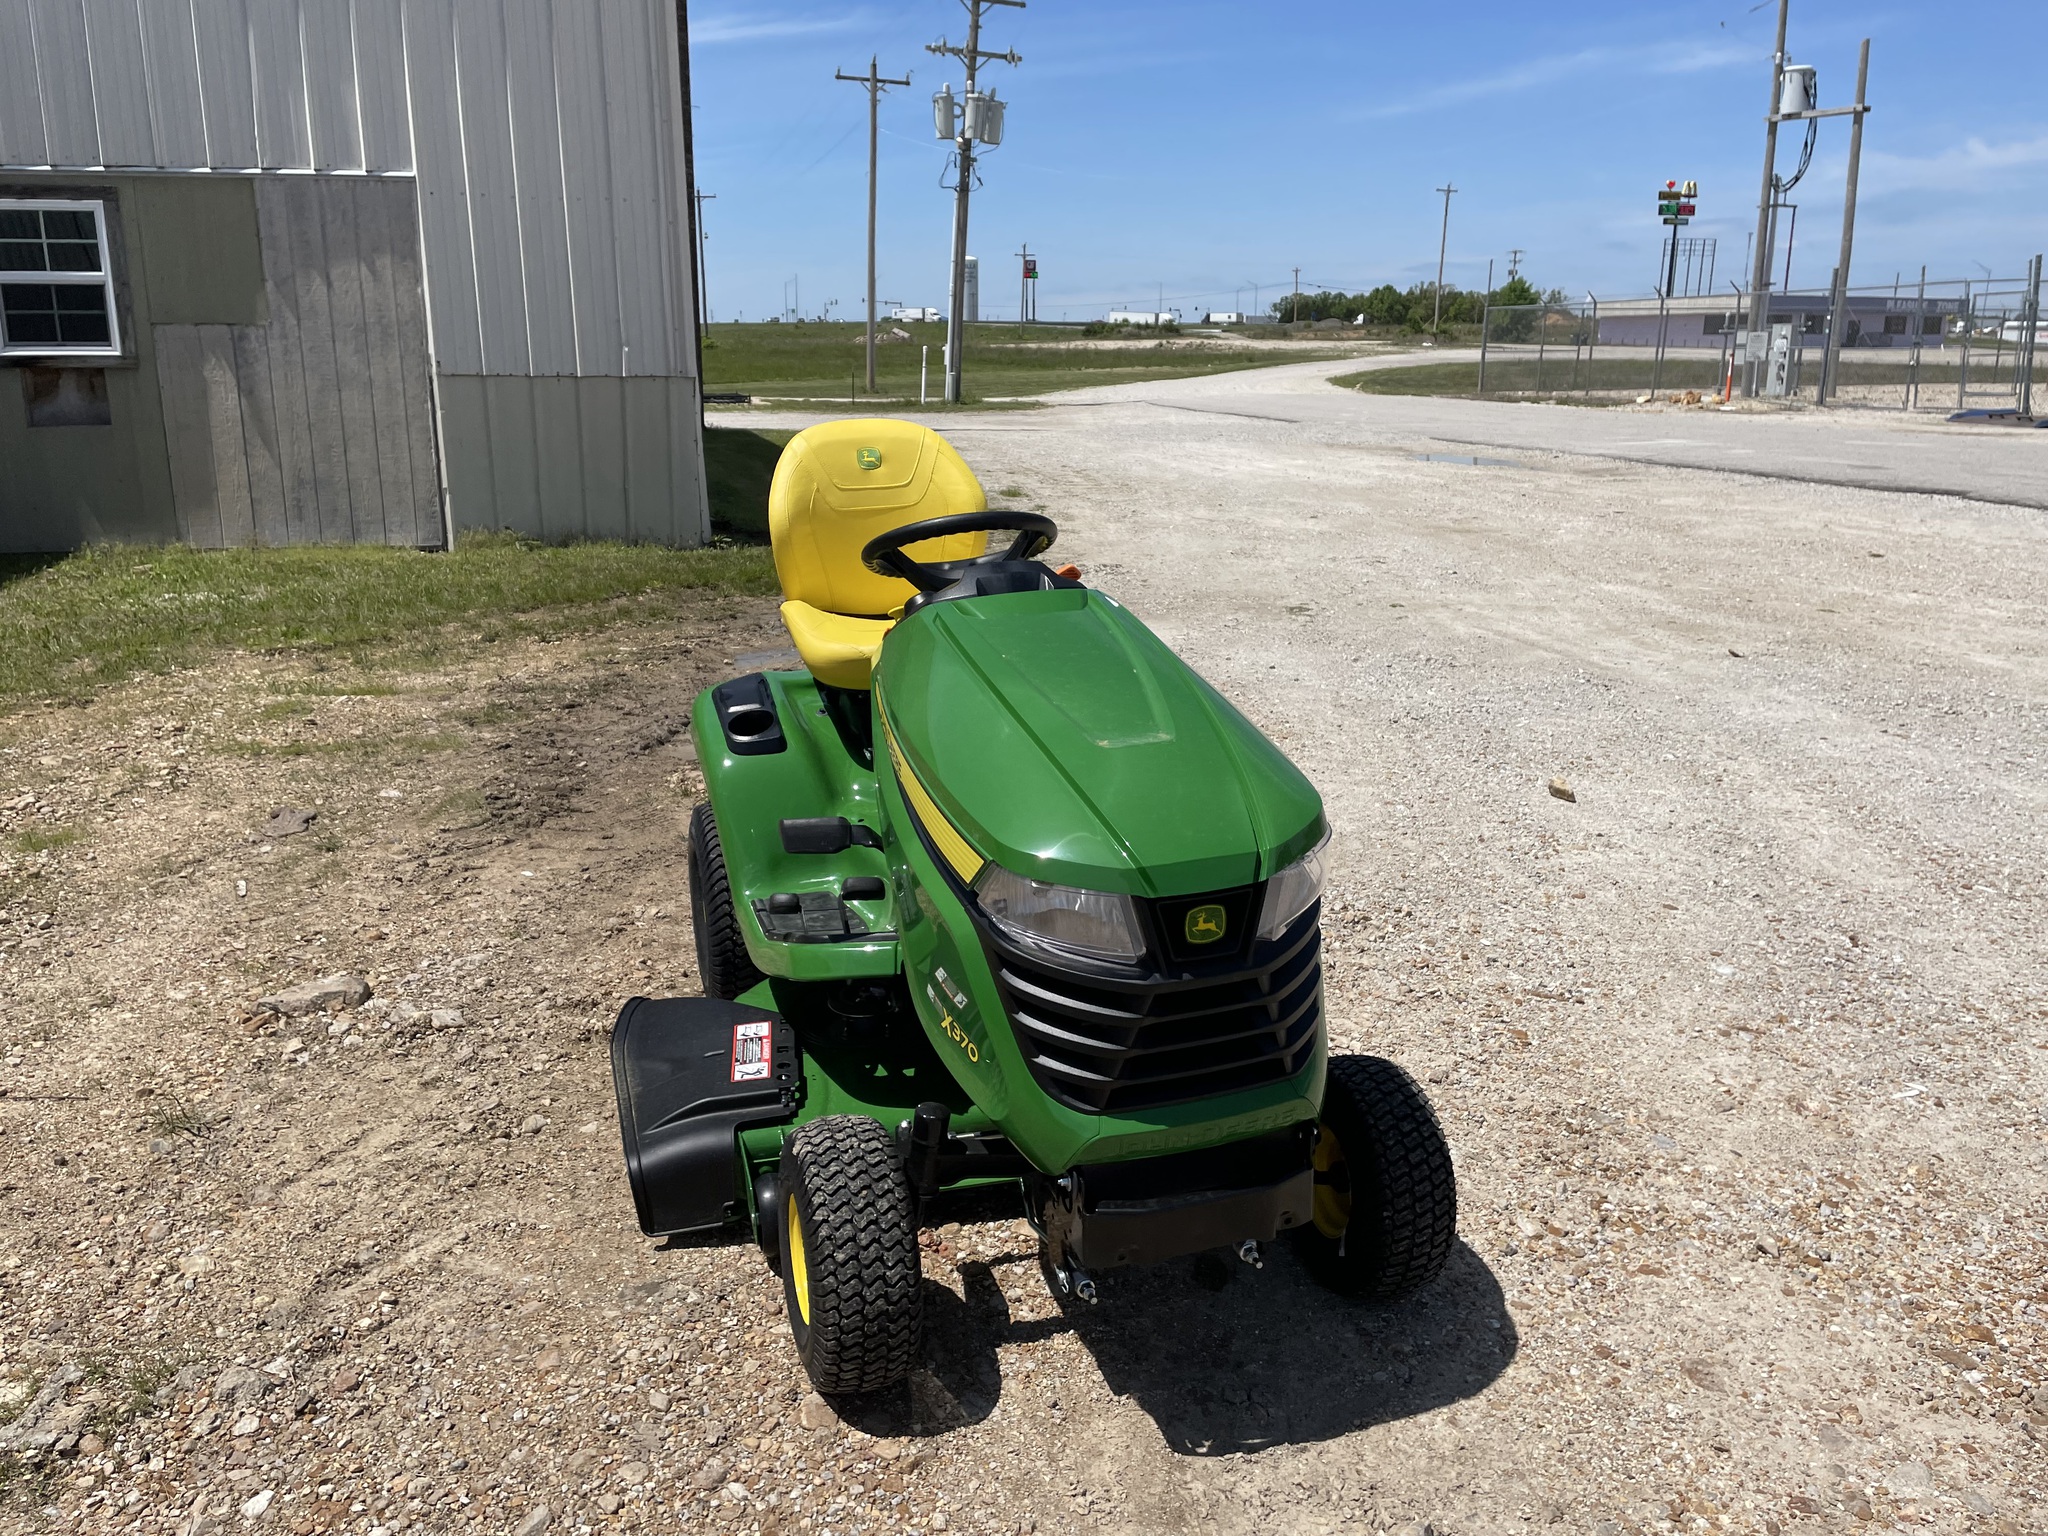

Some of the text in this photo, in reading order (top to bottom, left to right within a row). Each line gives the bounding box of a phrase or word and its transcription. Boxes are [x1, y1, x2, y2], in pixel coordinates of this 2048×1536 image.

[1886, 300, 1928, 311] PLEASUE
[940, 1006, 979, 1063] X370
[1203, 1107, 1297, 1139] DEERE
